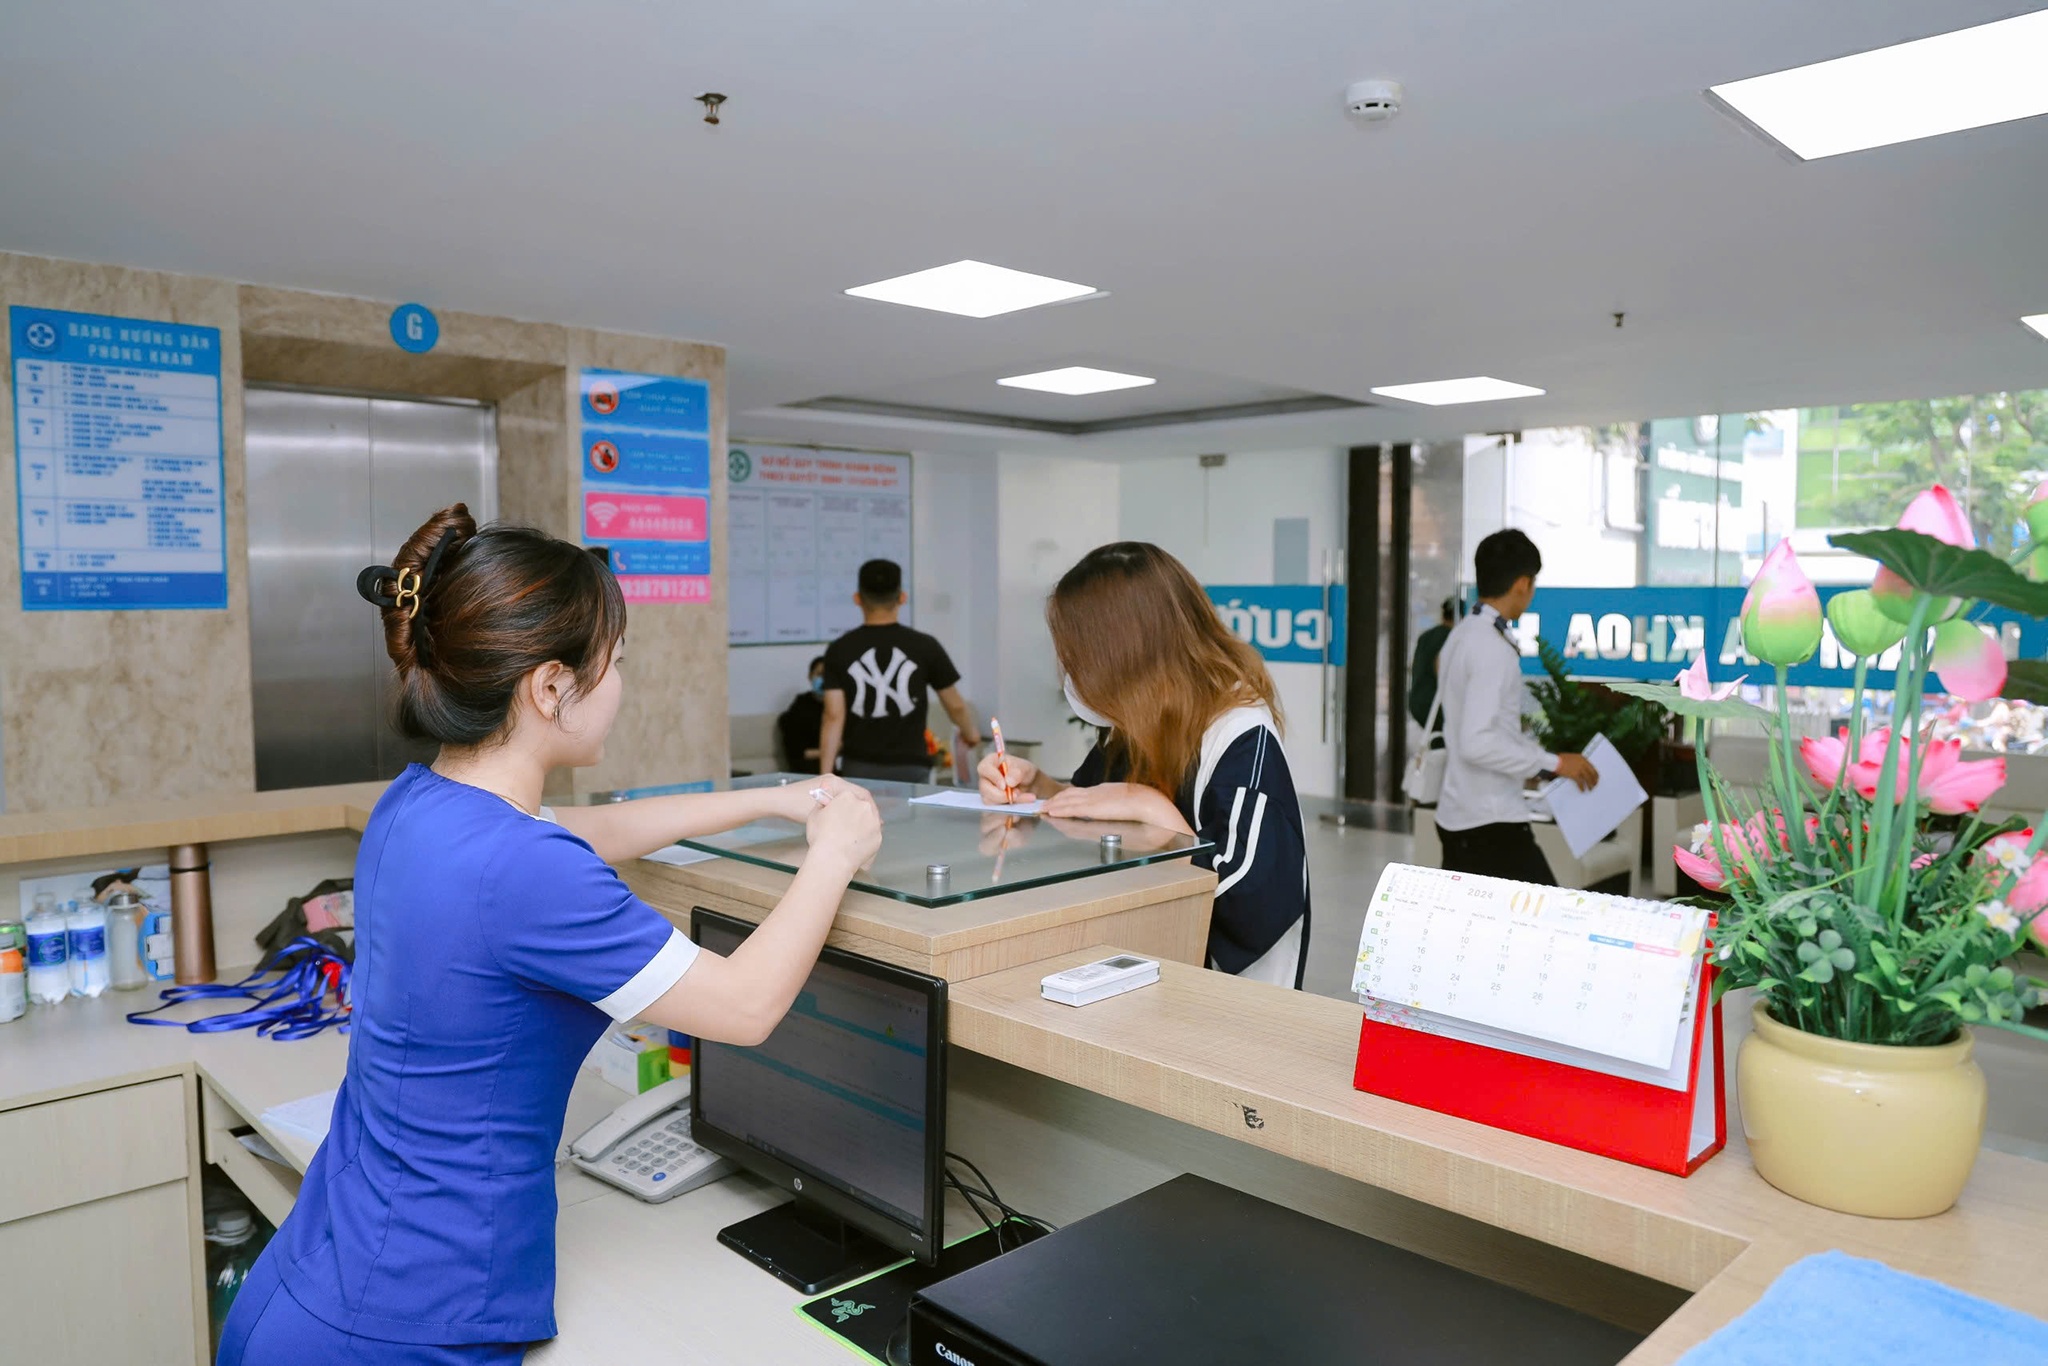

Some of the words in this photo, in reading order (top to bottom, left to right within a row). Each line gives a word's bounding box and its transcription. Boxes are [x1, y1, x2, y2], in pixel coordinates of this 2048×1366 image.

[406, 312, 424, 341] G
[1467, 888, 1494, 900] 2024
[1461, 936, 1470, 945] 10
[1543, 953, 1553, 962] 12
[1380, 938, 1389, 947] 15
[1417, 946, 1426, 955] 16
[1456, 954, 1465, 963] 17
[1496, 963, 1506, 972] 18
[1539, 972, 1549, 982] 19
[1581, 981, 1593, 992] 20
[1371, 974, 1381, 983] 29
[1409, 982, 1419, 992] 30
[1448, 991, 1457, 1001] 31
[1375, 956, 1385, 965] 22
[1412, 964, 1422, 973] 23
[1450, 973, 1460, 982] 24
[1490, 982, 1501, 992] 25
[1532, 991, 1544, 1001] 26
[1576, 1001, 1588, 1011] 27
[935, 1342, 975, 1366] Canon
